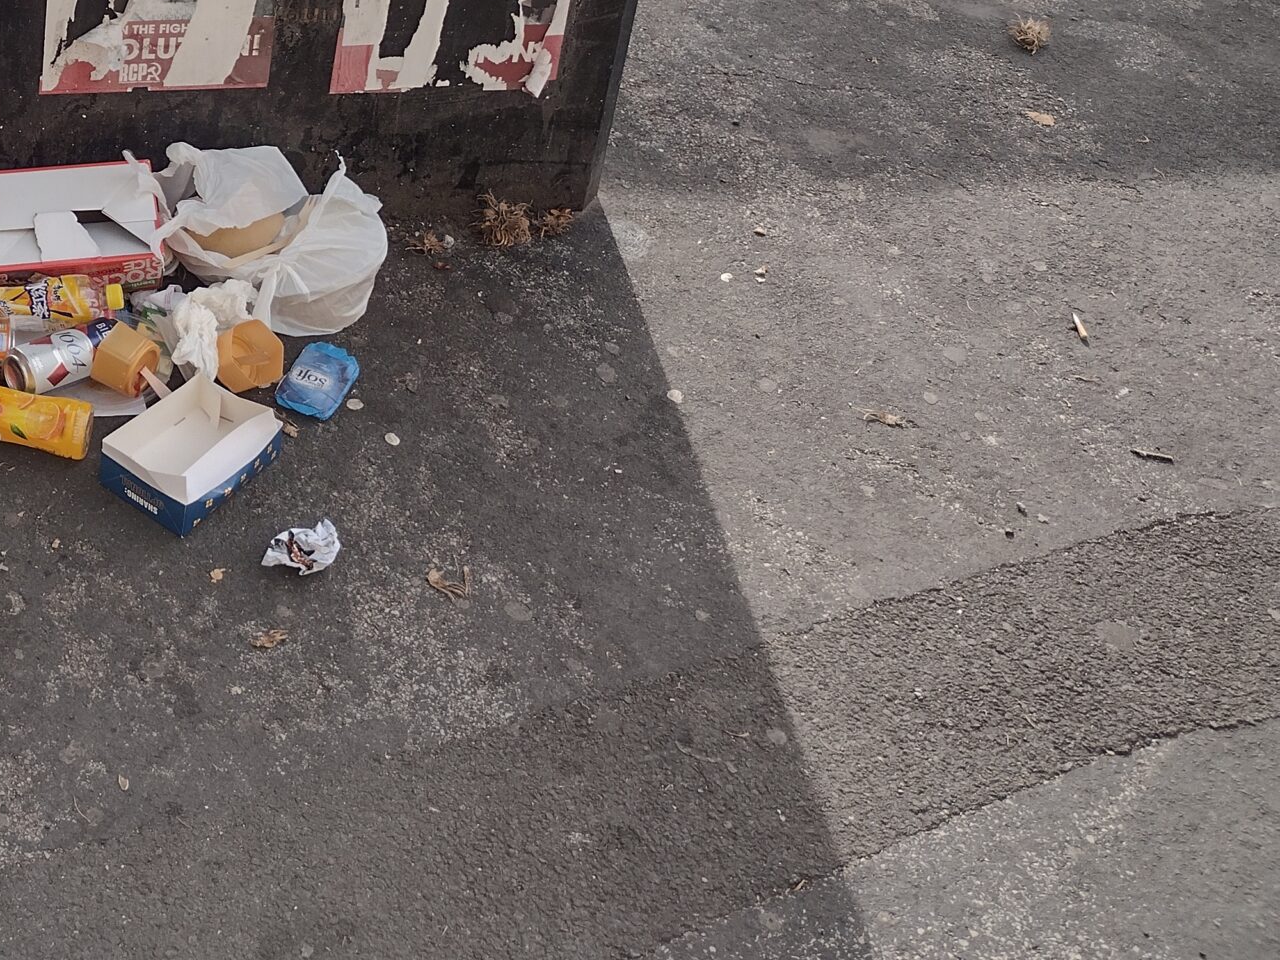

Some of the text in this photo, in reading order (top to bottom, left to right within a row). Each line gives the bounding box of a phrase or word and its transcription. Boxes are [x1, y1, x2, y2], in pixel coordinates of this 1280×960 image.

[132, 24, 156, 34] THE
[159, 23, 190, 34] FIGH
[119, 63, 148, 82] RCP
[55, 331, 88, 373] 1664
[295, 369, 328, 385] soft
[124, 487, 158, 515] SHARING:
